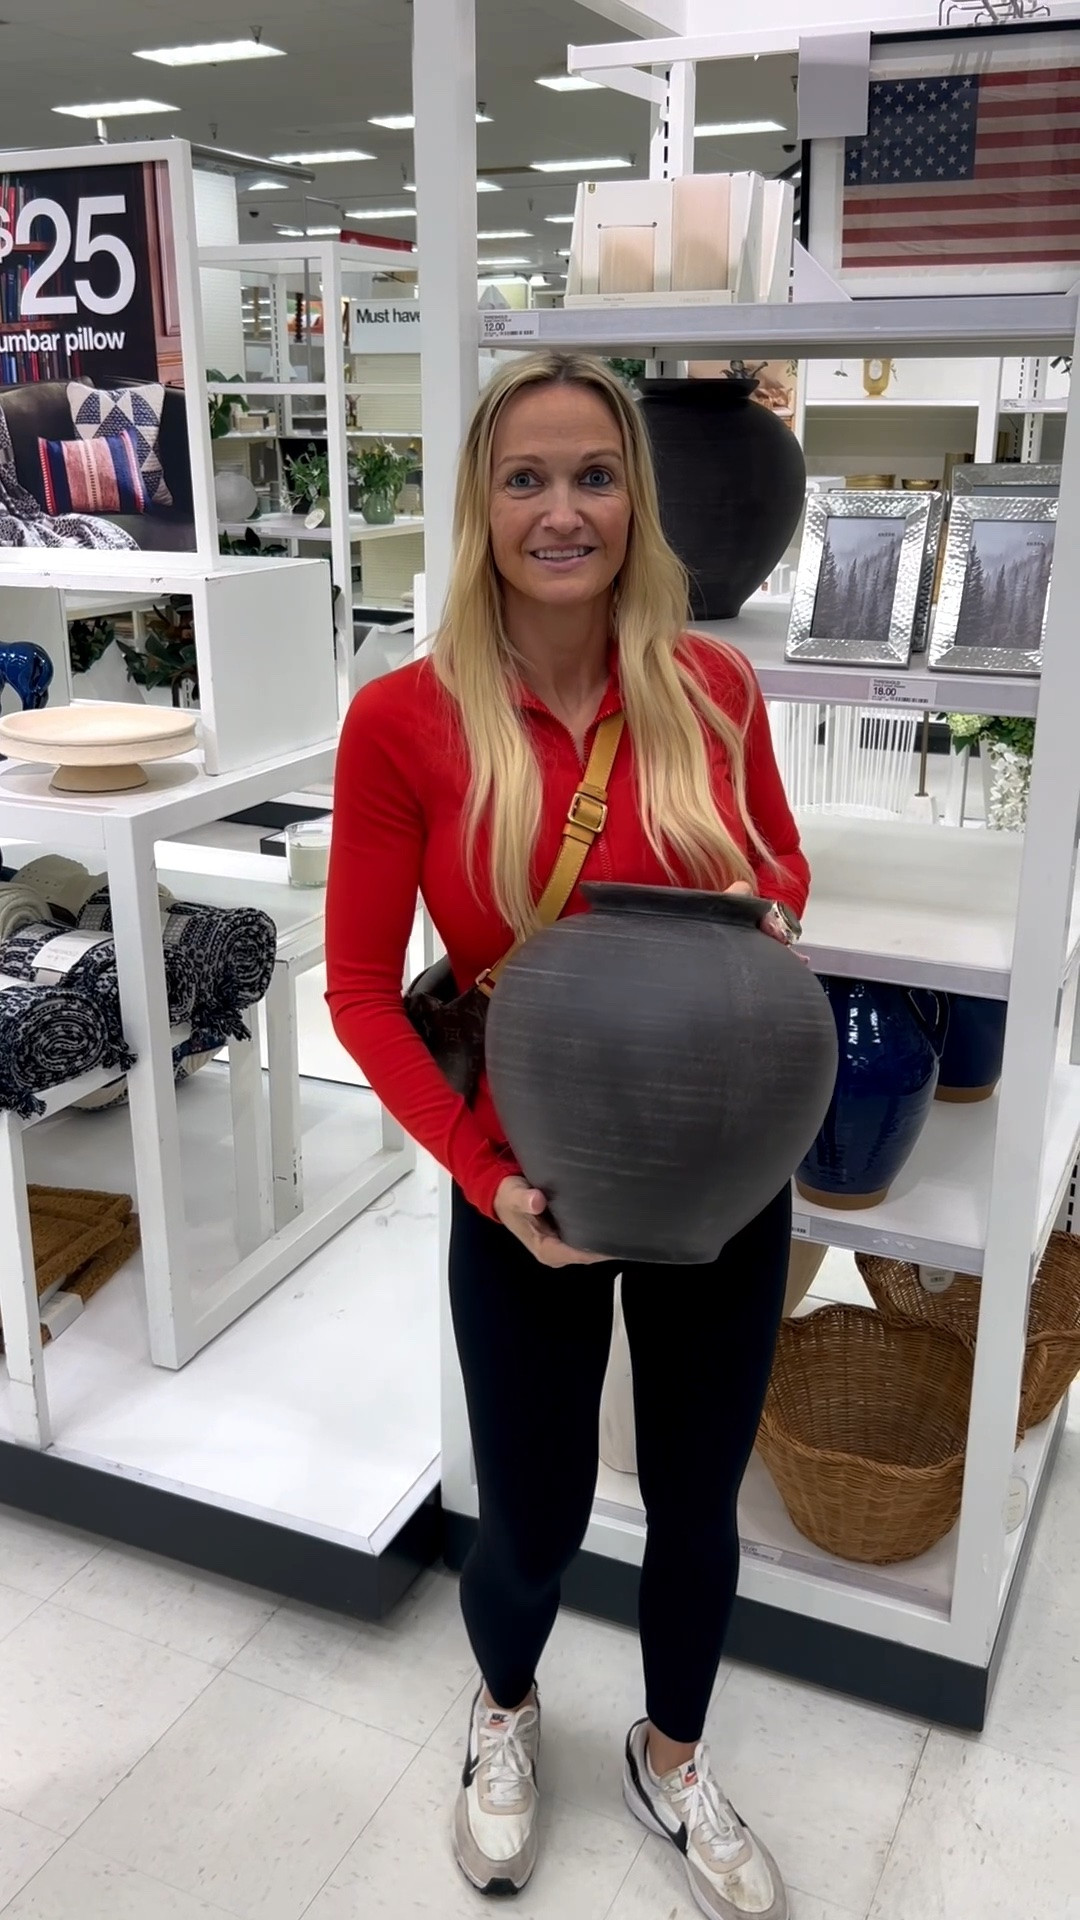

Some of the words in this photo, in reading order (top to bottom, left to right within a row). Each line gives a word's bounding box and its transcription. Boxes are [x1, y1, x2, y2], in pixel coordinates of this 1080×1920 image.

[356, 308, 389, 323] Must
[485, 322, 505, 331] 12.00
[65, 326, 125, 356] pillow
[873, 687, 897, 696] 18.00
